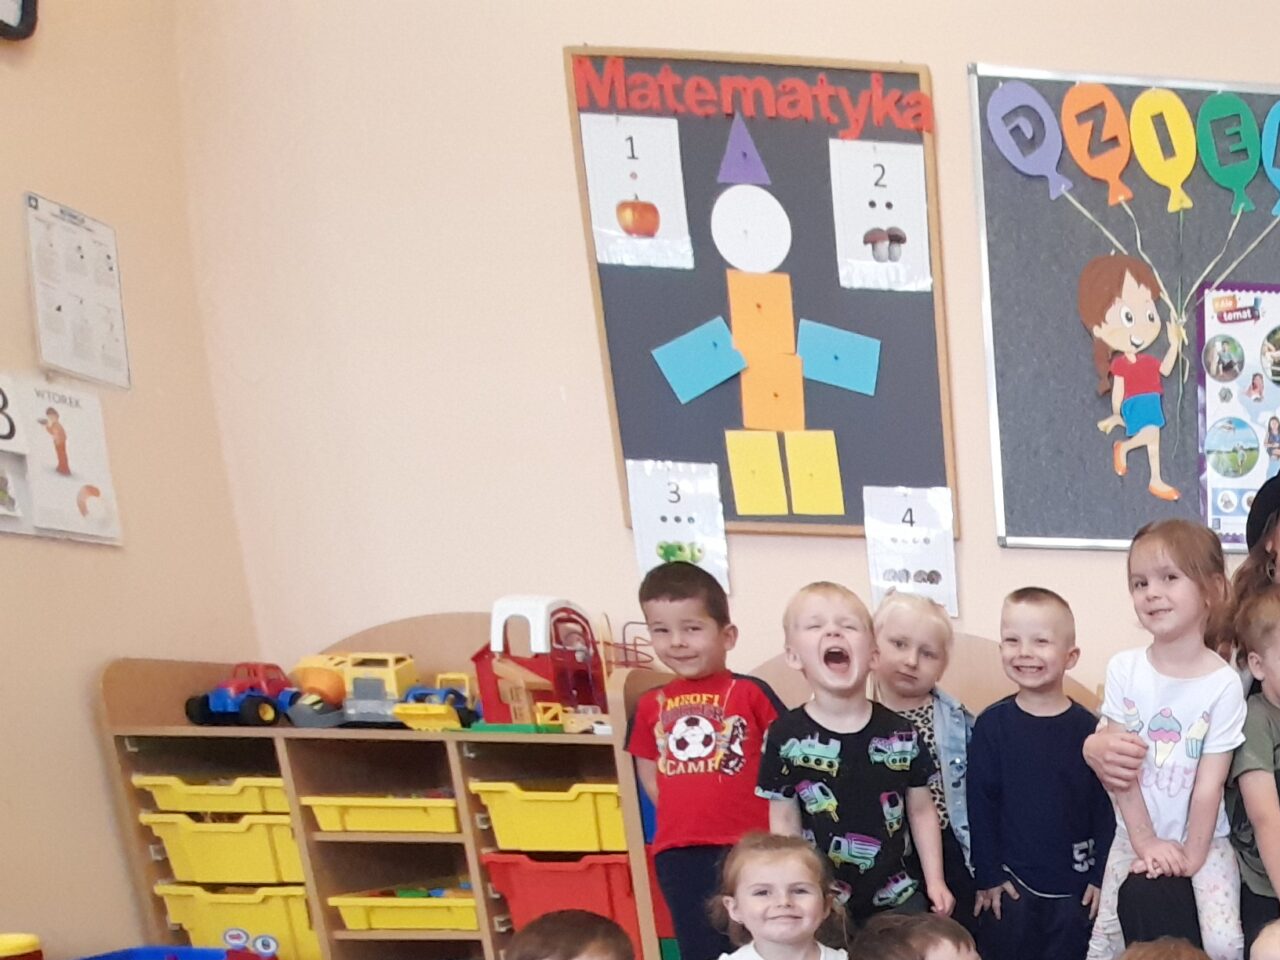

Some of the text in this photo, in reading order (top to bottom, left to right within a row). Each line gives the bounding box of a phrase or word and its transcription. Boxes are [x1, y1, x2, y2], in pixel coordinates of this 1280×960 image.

[572, 55, 934, 140] Matematyka
[624, 135, 640, 160] 1
[872, 163, 888, 187] 2
[666, 482, 681, 504] 3
[901, 507, 916, 527] 4
